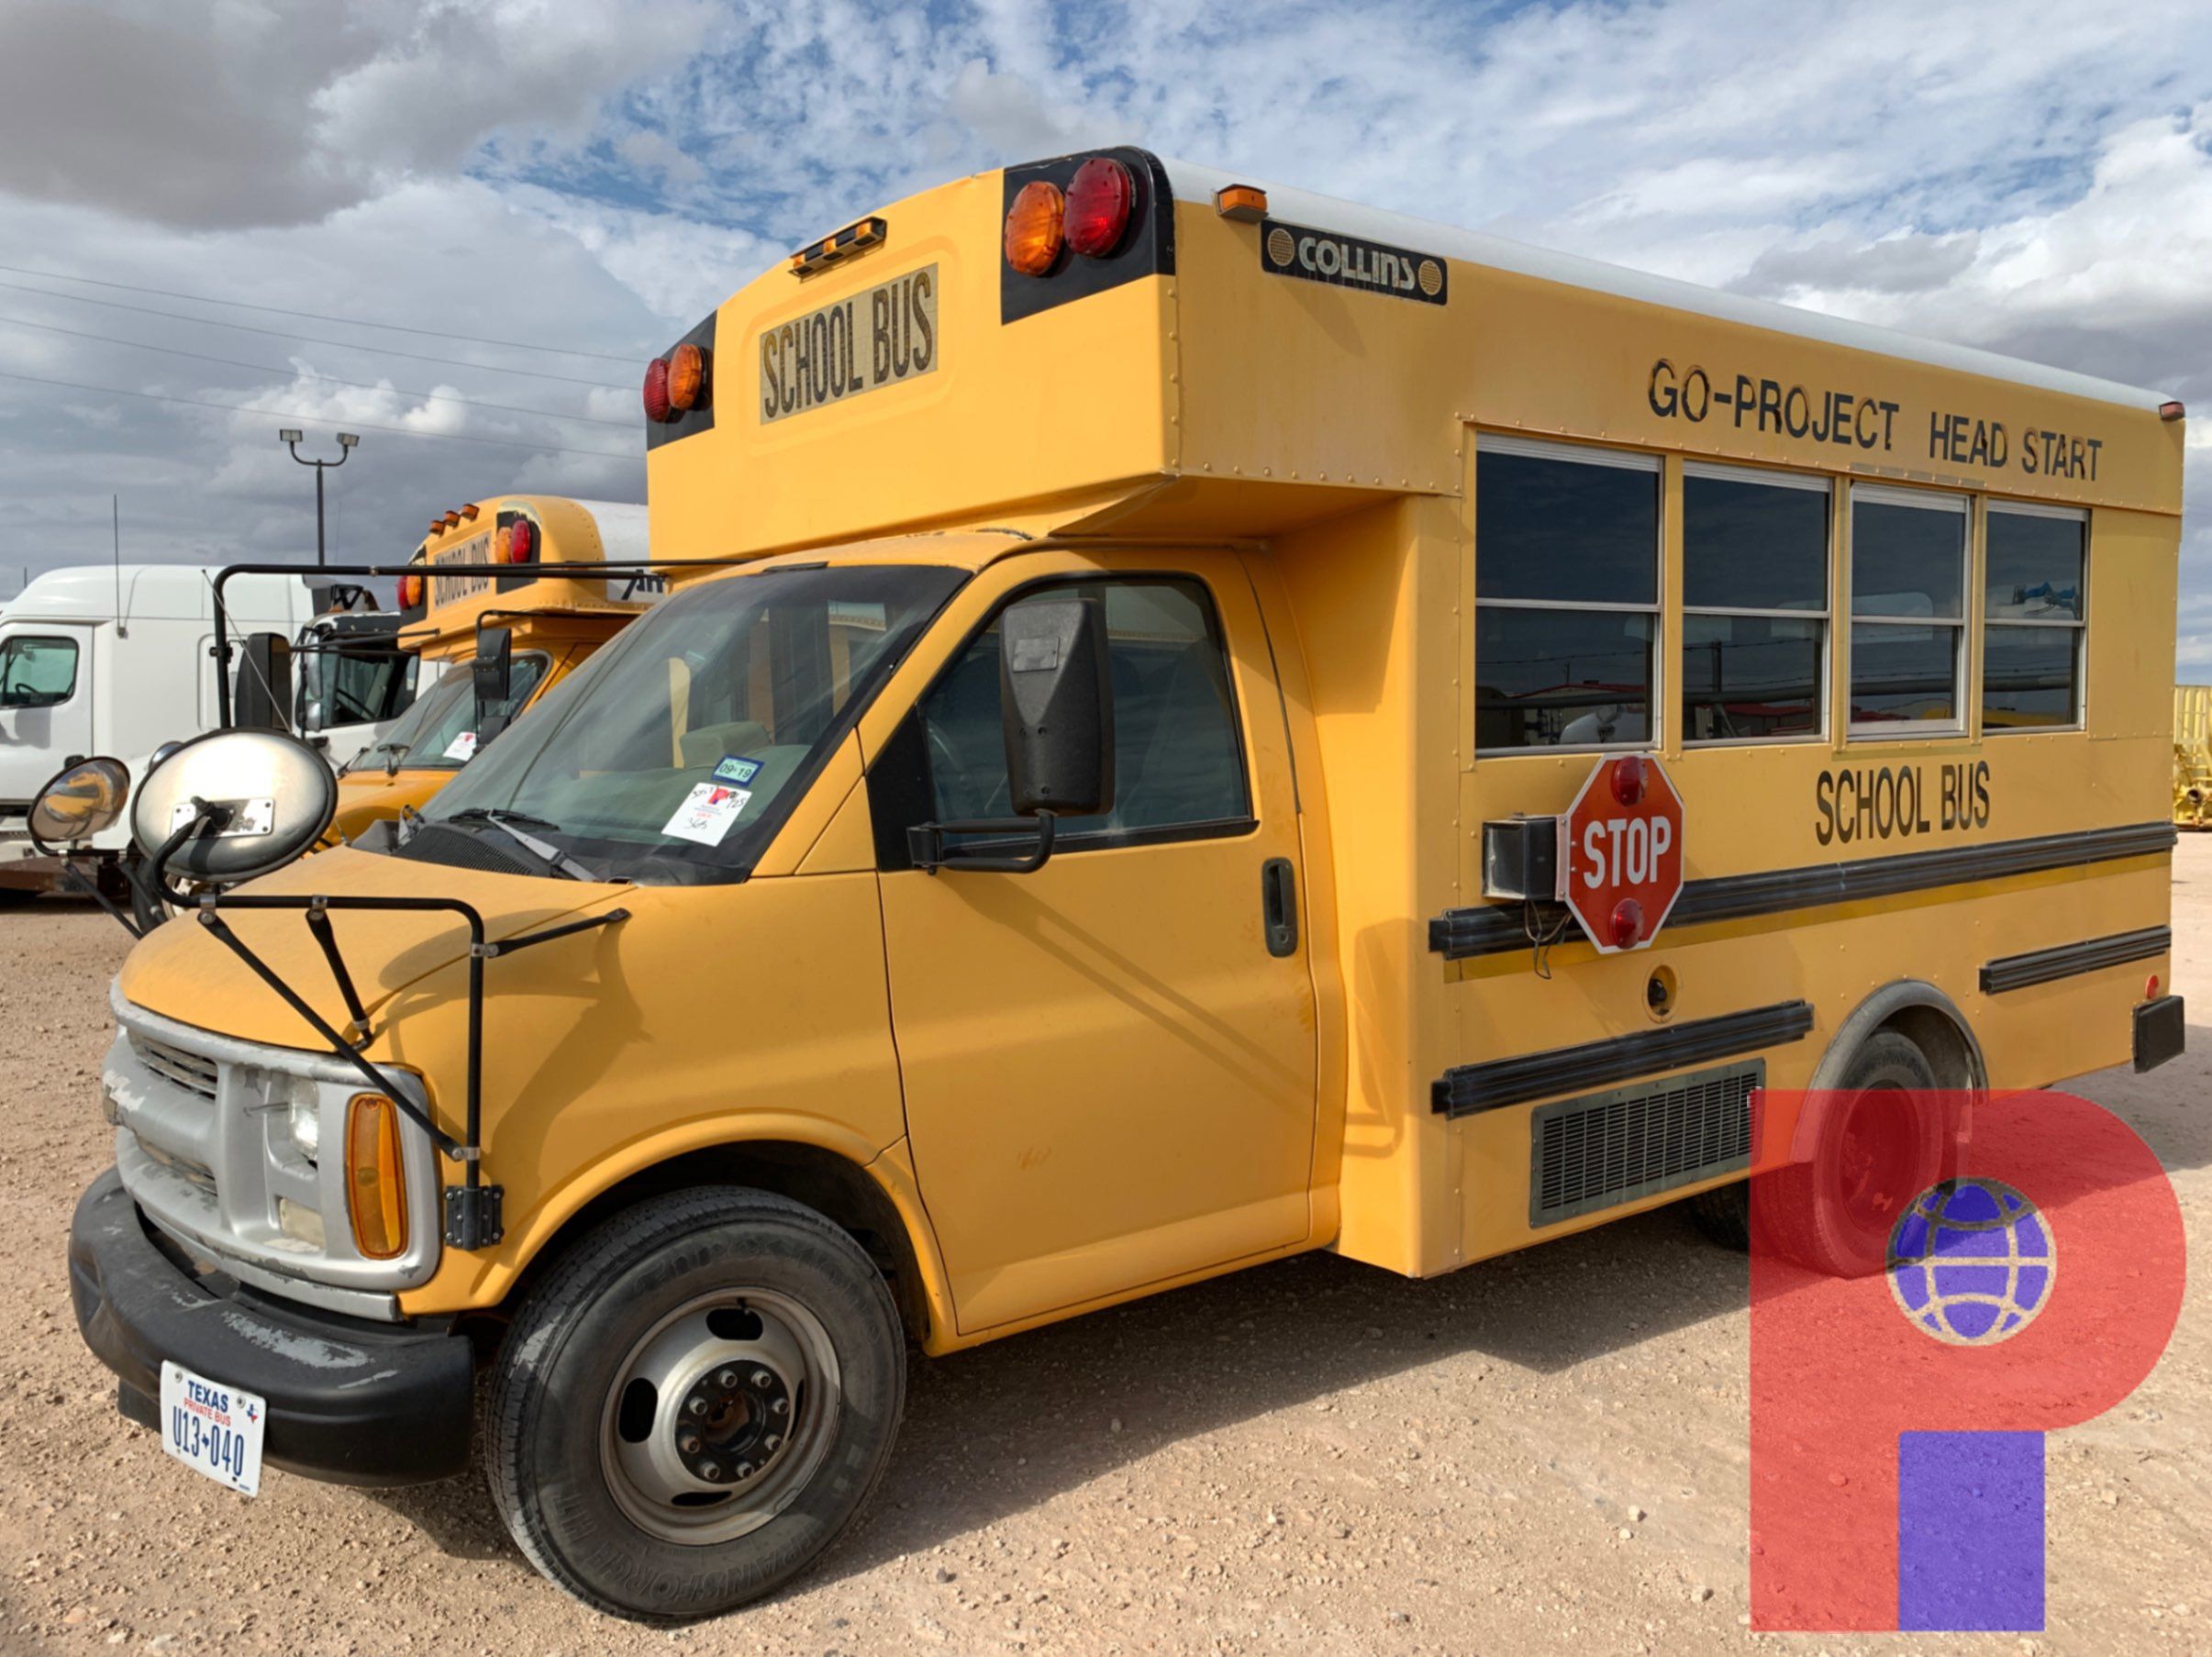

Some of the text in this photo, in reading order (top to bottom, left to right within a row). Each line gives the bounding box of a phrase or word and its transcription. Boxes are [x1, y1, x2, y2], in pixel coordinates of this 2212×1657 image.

[763, 271, 932, 418] SCHOOL BUS
[1649, 358, 2103, 482] GO-PROJECT HEAD START
[1816, 760, 1990, 846] SCHOOL BUS
[1583, 815, 1672, 889] STOP
[183, 1397, 232, 1428] PRIVATE BUS
[187, 1379, 229, 1413] TEXAS
